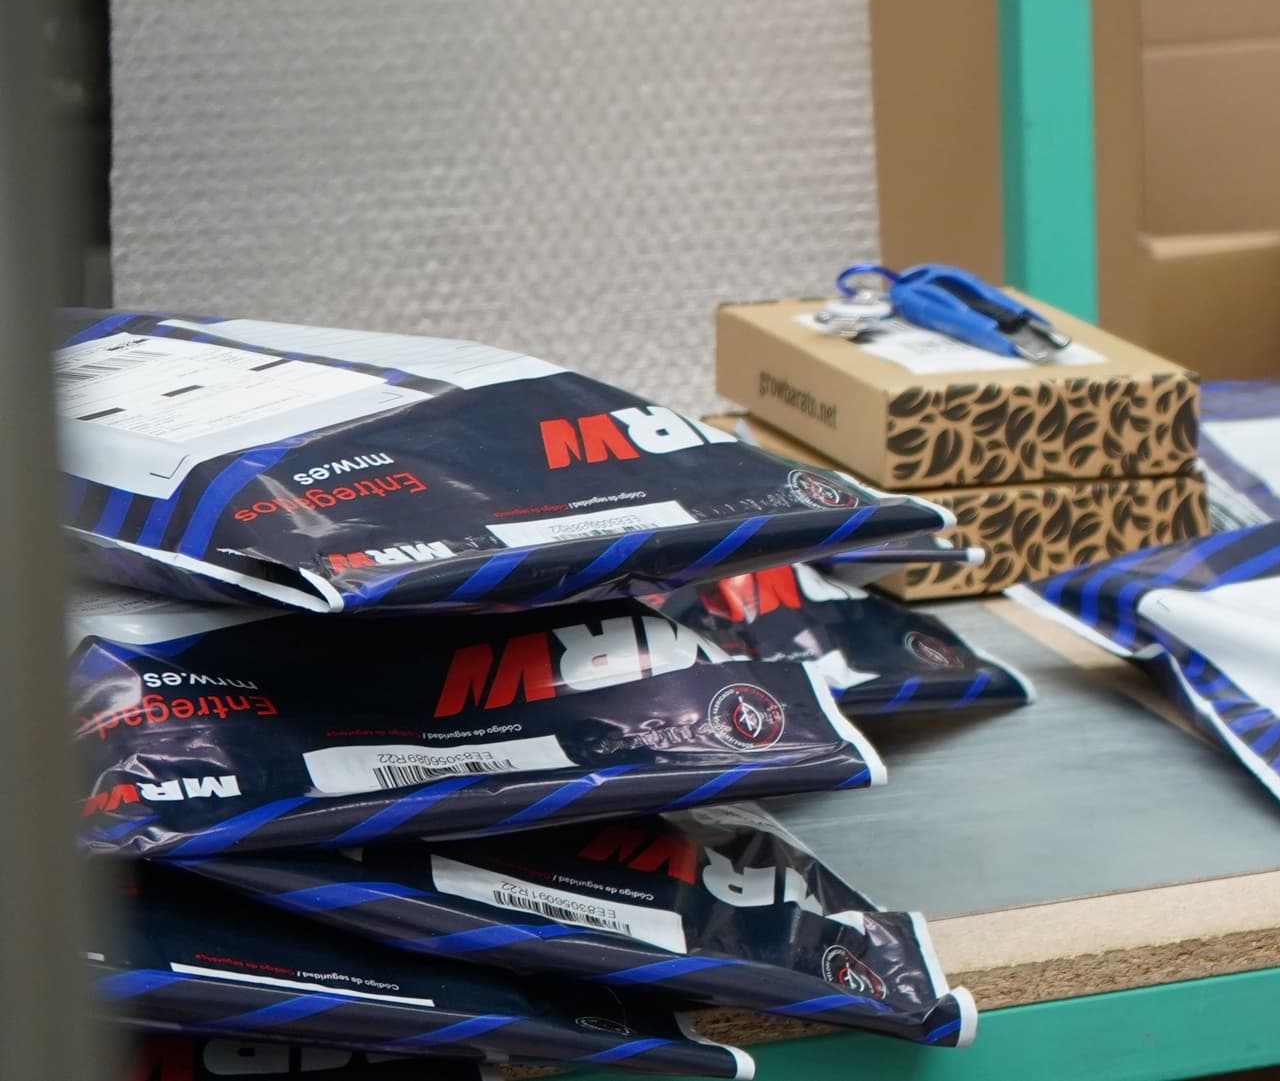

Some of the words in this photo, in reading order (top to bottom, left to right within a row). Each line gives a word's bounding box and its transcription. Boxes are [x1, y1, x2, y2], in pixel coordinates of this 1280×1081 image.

[540, 406, 738, 470] RW
[293, 453, 395, 485] mrw.es
[233, 472, 427, 522] Entregados
[329, 541, 456, 574] MRW
[143, 672, 258, 691] mrw.es
[82, 775, 241, 816] MRW
